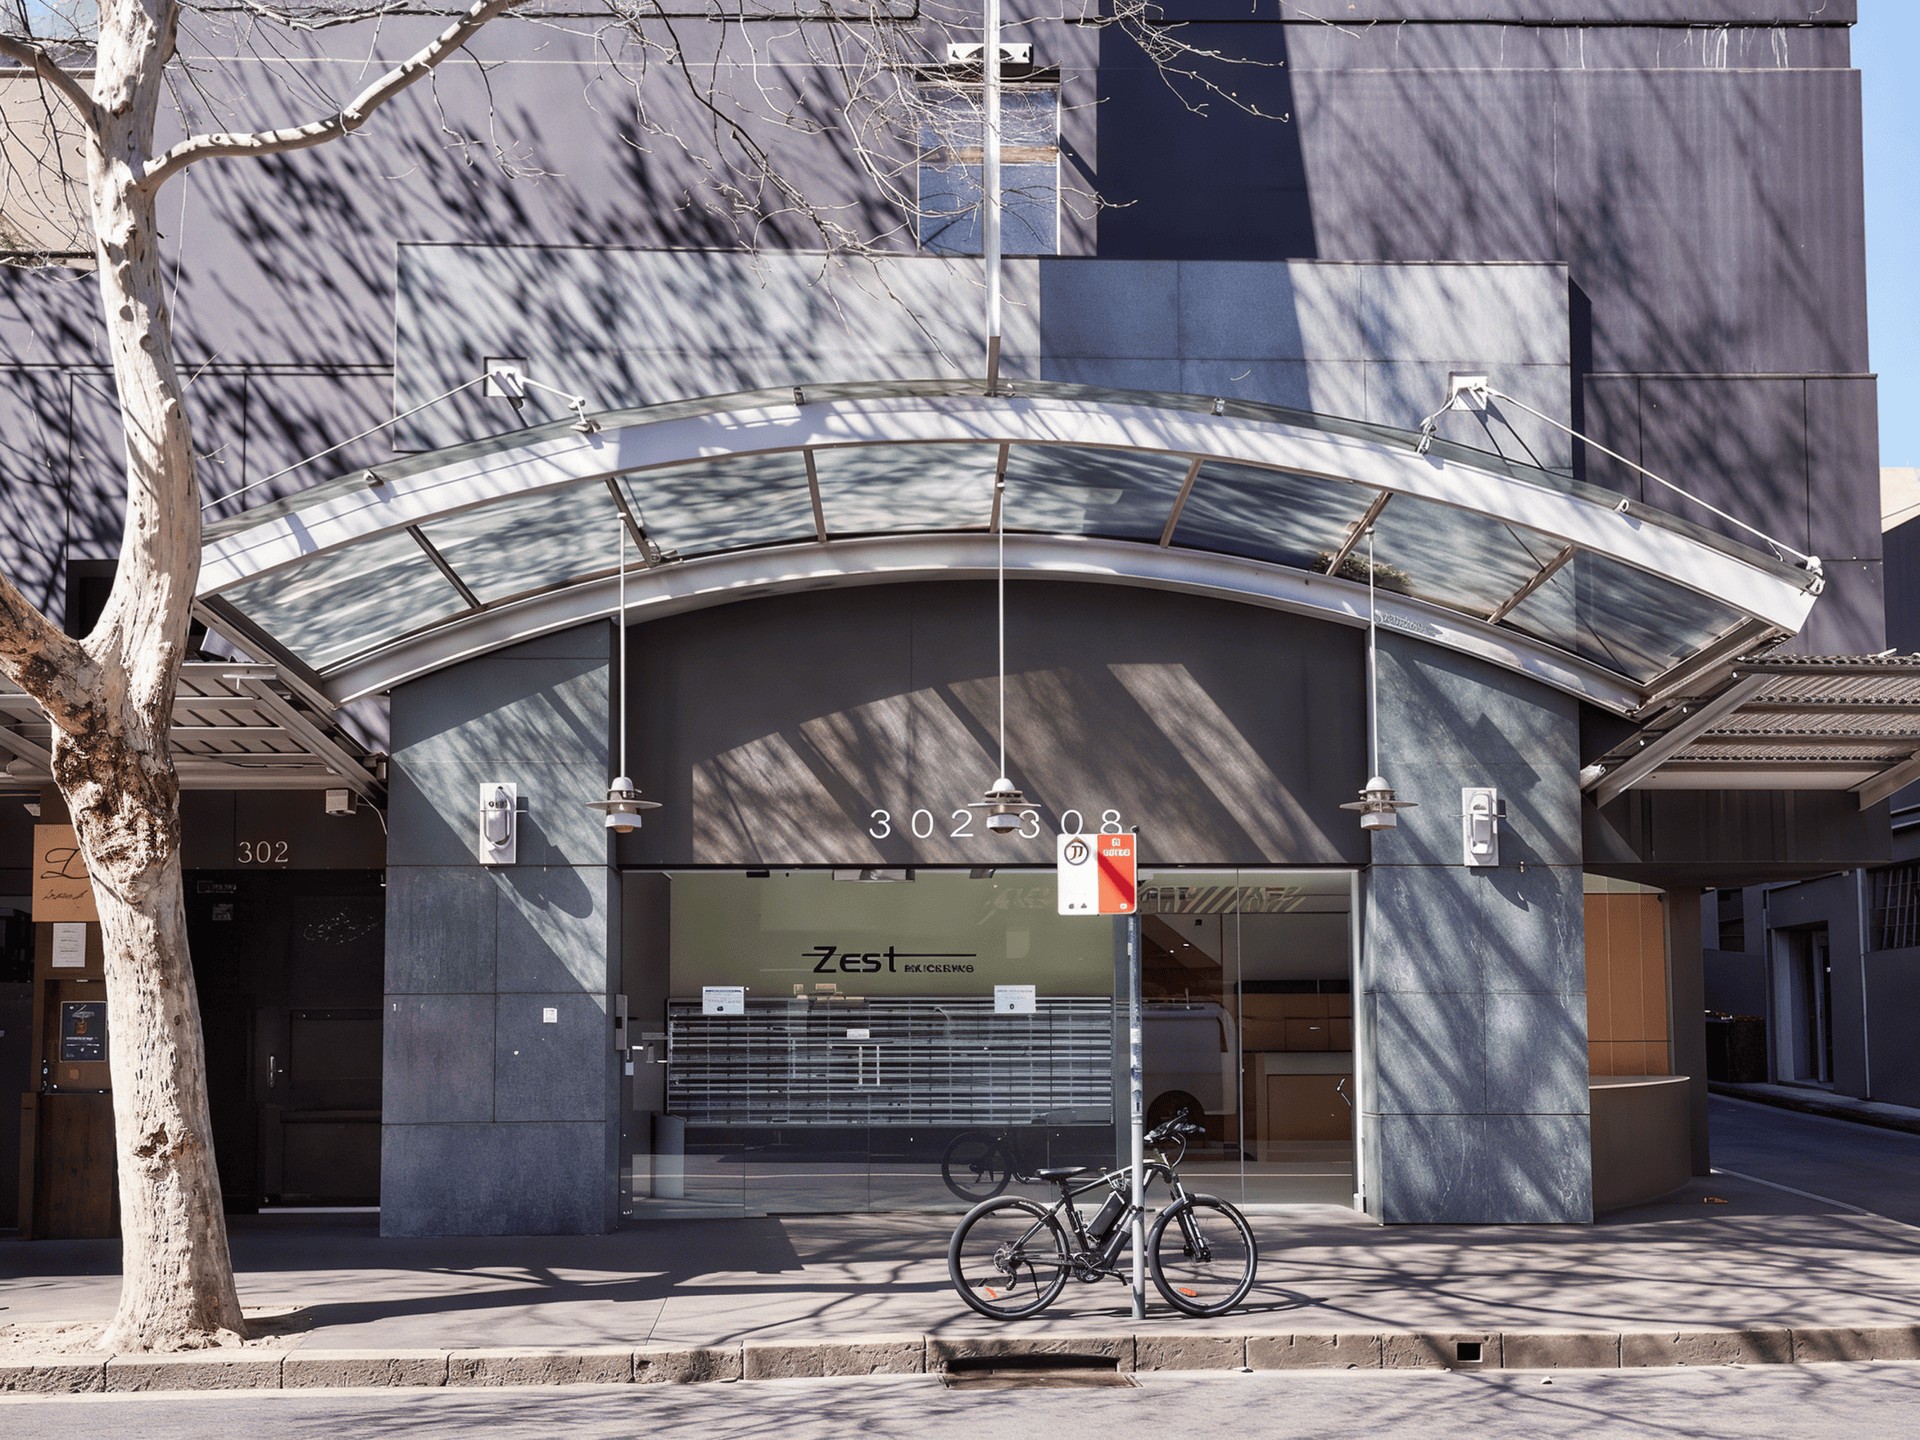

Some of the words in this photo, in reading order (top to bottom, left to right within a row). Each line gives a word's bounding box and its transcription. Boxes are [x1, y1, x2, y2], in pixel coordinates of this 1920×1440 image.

[869, 809, 974, 839] 302
[237, 841, 289, 863] 302
[812, 945, 897, 973] Zest
